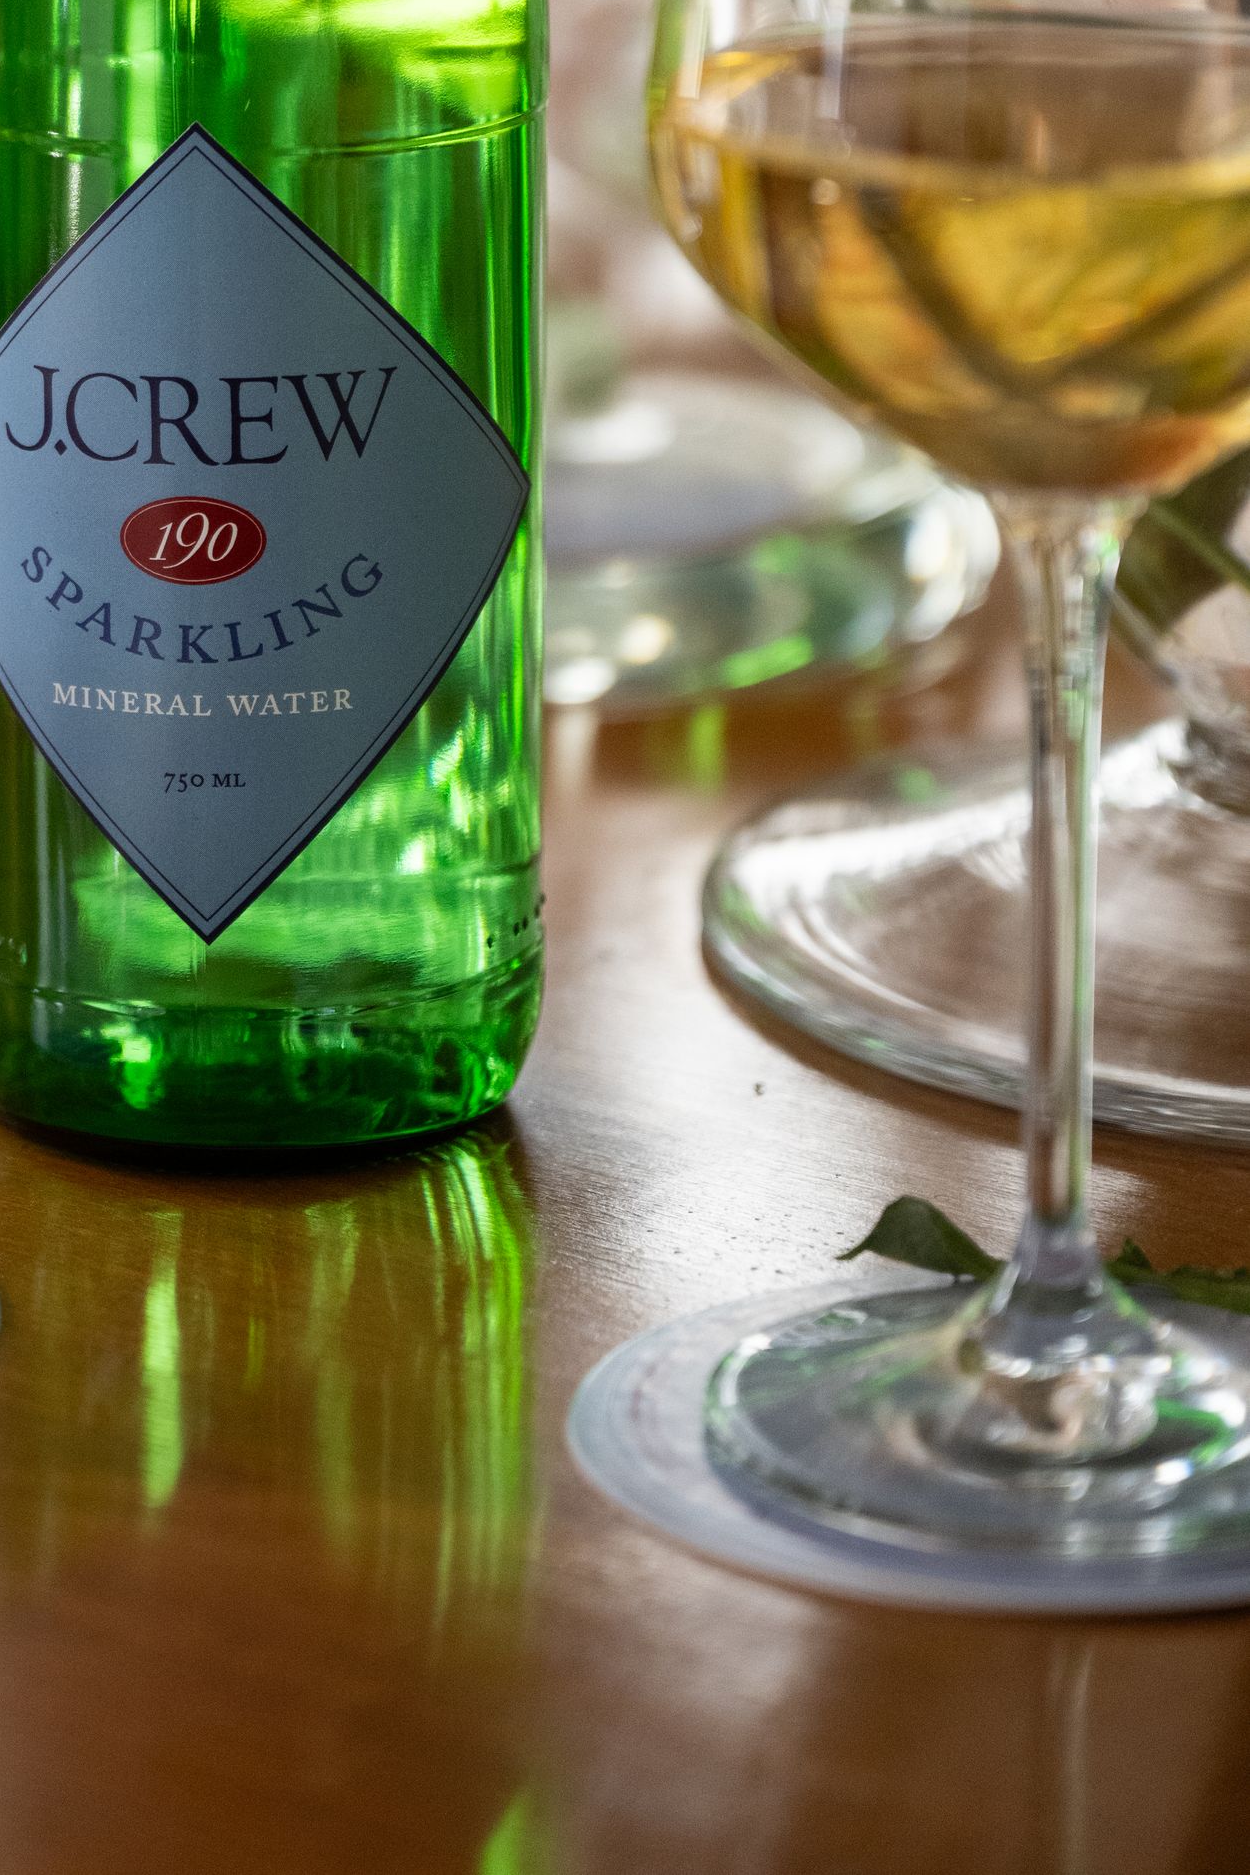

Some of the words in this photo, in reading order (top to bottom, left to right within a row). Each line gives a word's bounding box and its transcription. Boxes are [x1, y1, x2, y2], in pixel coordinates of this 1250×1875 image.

[5, 363, 399, 468] J.CREW
[148, 511, 239, 570] 190
[20, 545, 385, 665] SPARKLING
[52, 681, 213, 717] MINERAL
[226, 687, 355, 718] WATER
[163, 771, 206, 794] 750
[211, 772, 247, 789] ML
